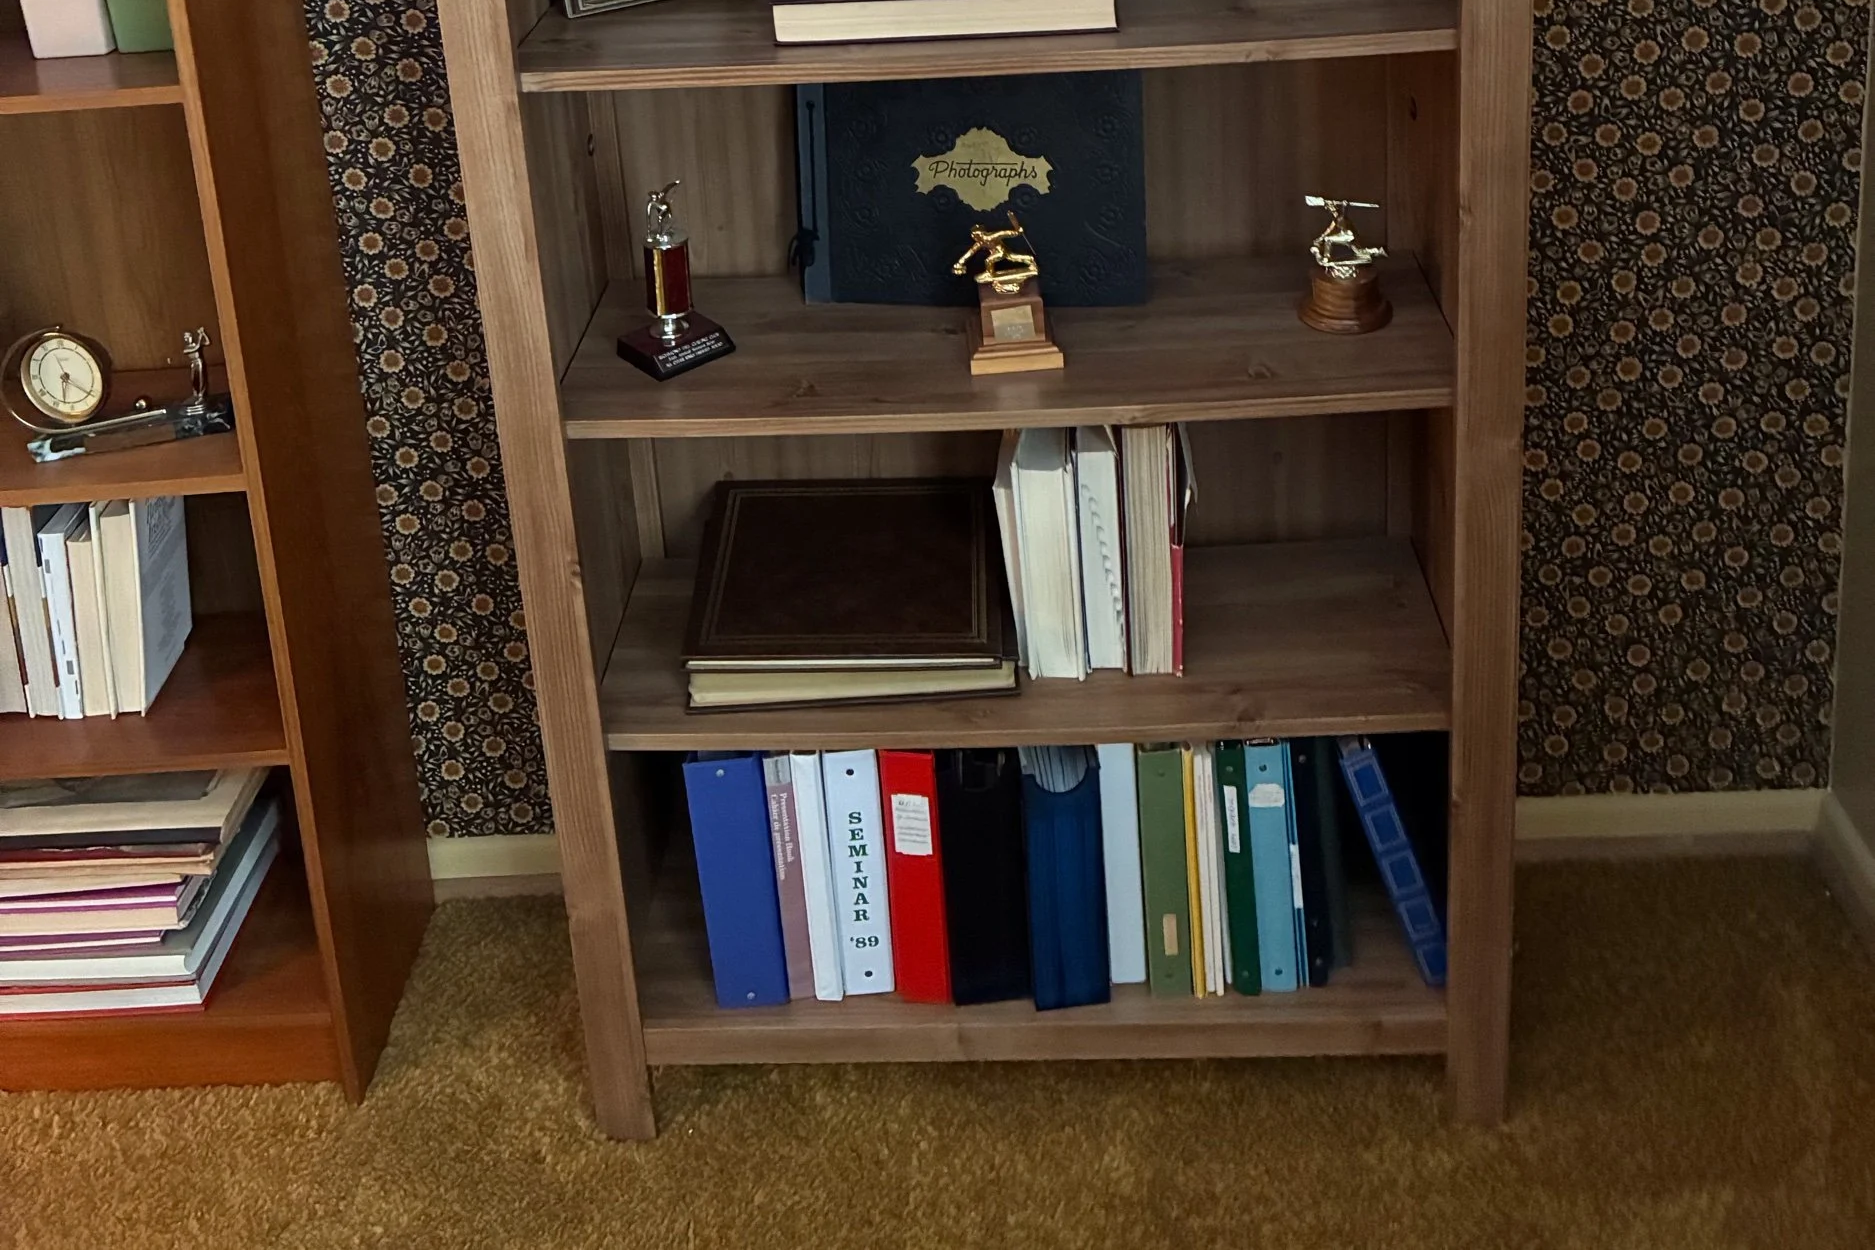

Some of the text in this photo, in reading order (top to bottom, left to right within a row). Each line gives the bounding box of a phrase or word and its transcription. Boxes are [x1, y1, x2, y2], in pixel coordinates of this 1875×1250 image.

[928, 158, 1038, 186] Photographs
[773, 822, 781, 831] de
[779, 792, 790, 842] Presentation
[847, 811, 870, 922] SEMINAR
